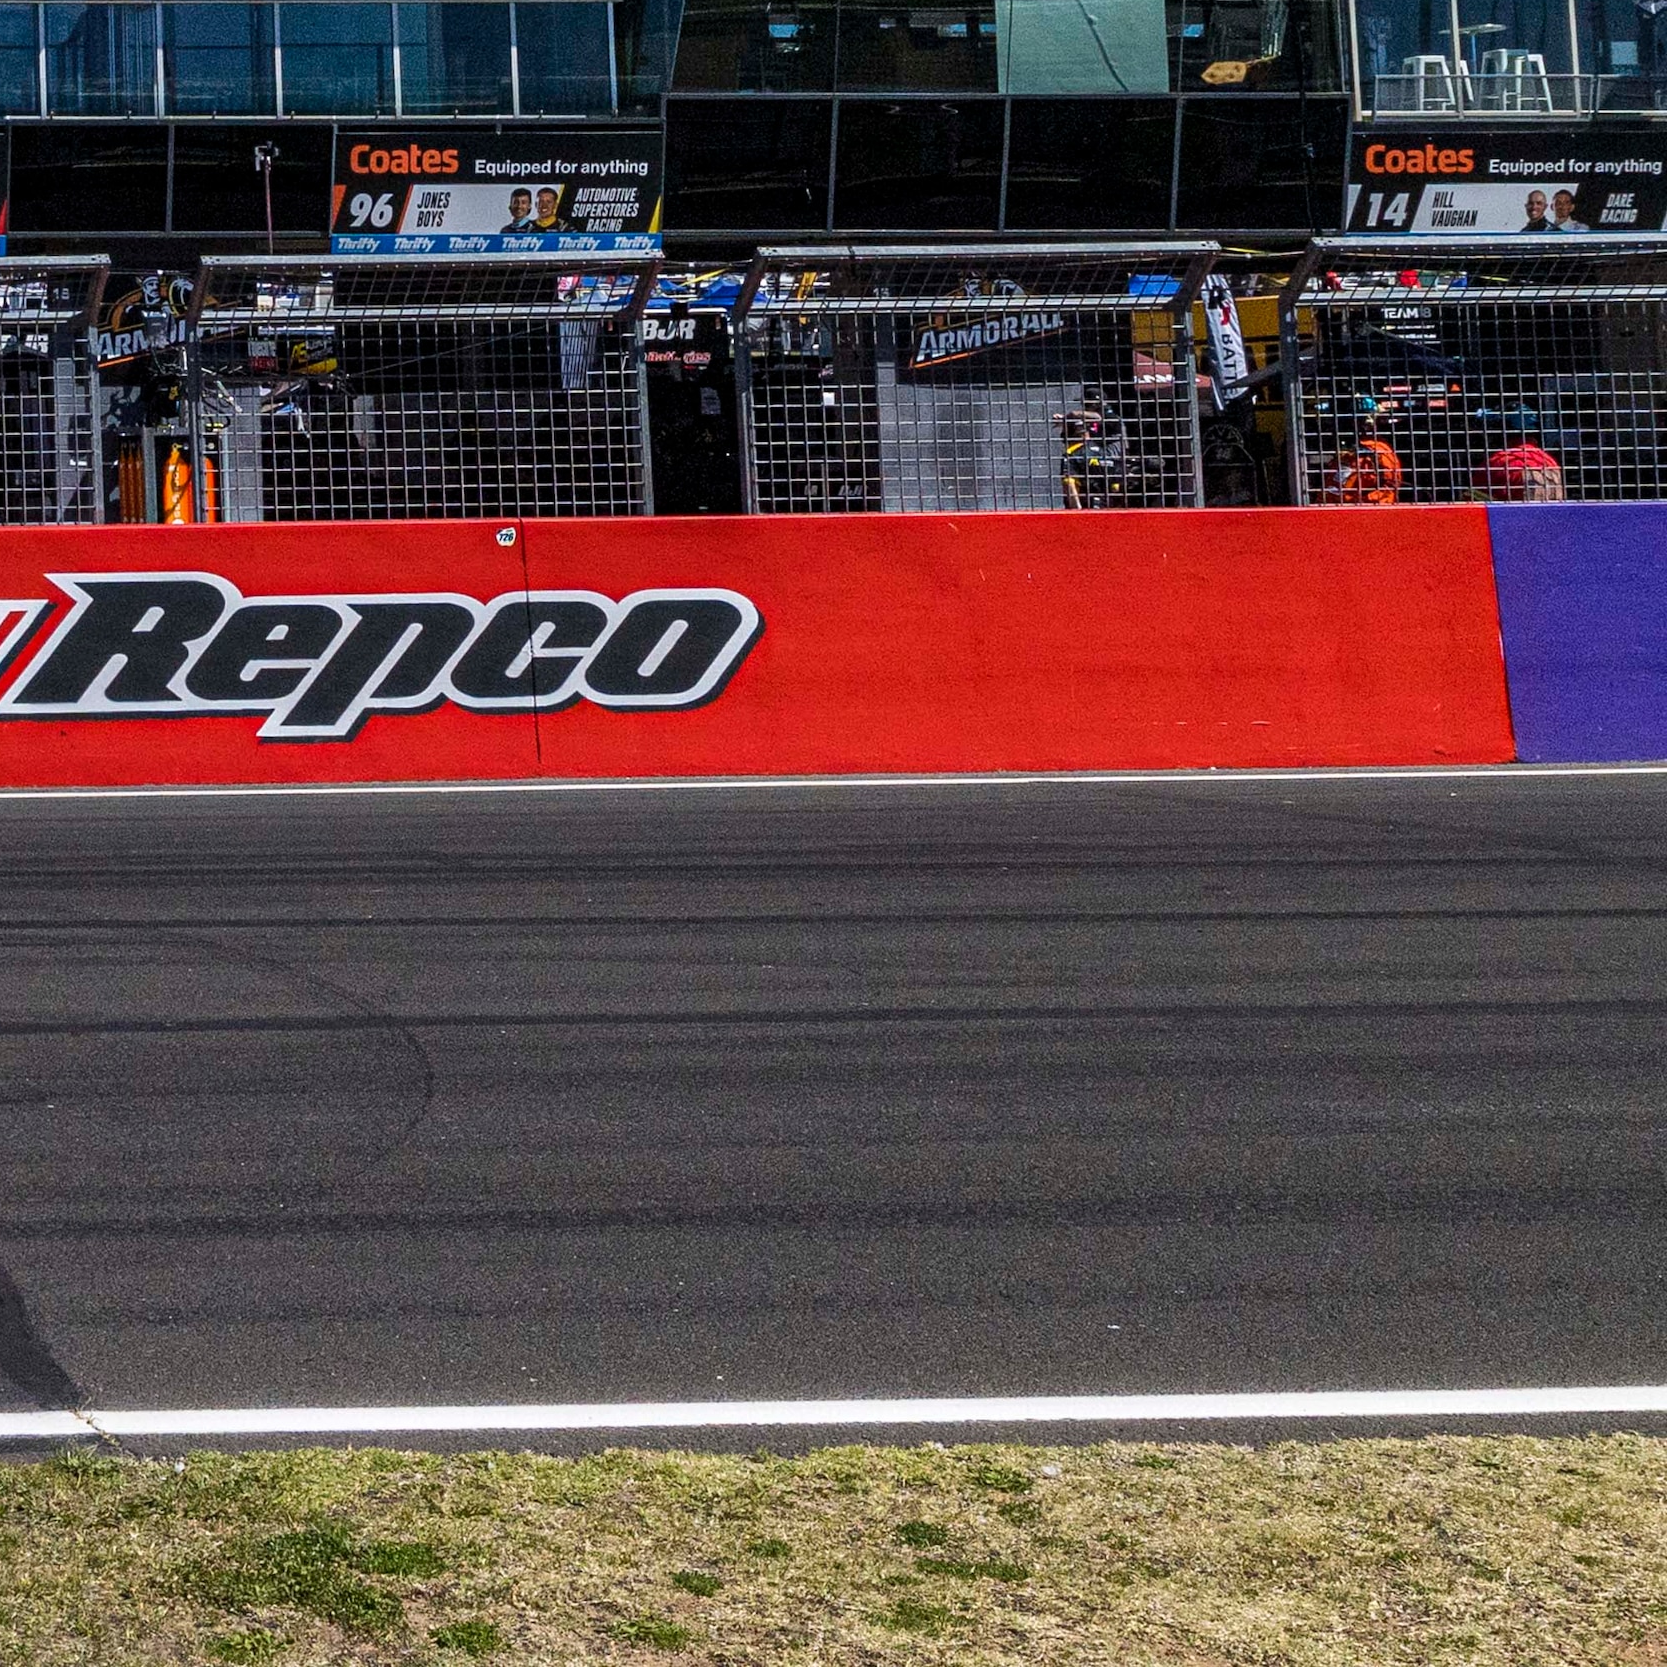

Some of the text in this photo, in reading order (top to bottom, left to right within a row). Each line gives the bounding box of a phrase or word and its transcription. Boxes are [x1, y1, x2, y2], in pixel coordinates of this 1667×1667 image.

[350, 144, 459, 174] Coates
[1365, 144, 1475, 174] Coates
[1489, 159, 1662, 175] Equipped for anything
[475, 159, 648, 177] Equipped for anything
[417, 191, 451, 209] JONES
[575, 187, 636, 202] AUTOMOTIVE
[1432, 191, 1454, 208] HILL
[1606, 193, 1634, 208] DARE
[349, 192, 393, 228] 96
[571, 203, 639, 218] SUPERSTORES
[1366, 192, 1410, 227] 14
[1599, 209, 1637, 224] RACING
[417, 210, 444, 228] BOYS
[586, 218, 623, 232] RACING
[1431, 210, 1478, 227] VAUGHAN
[338, 236, 654, 252] Thrifty Thrifty Thrifty Thrifty Thrifty Thrifty
